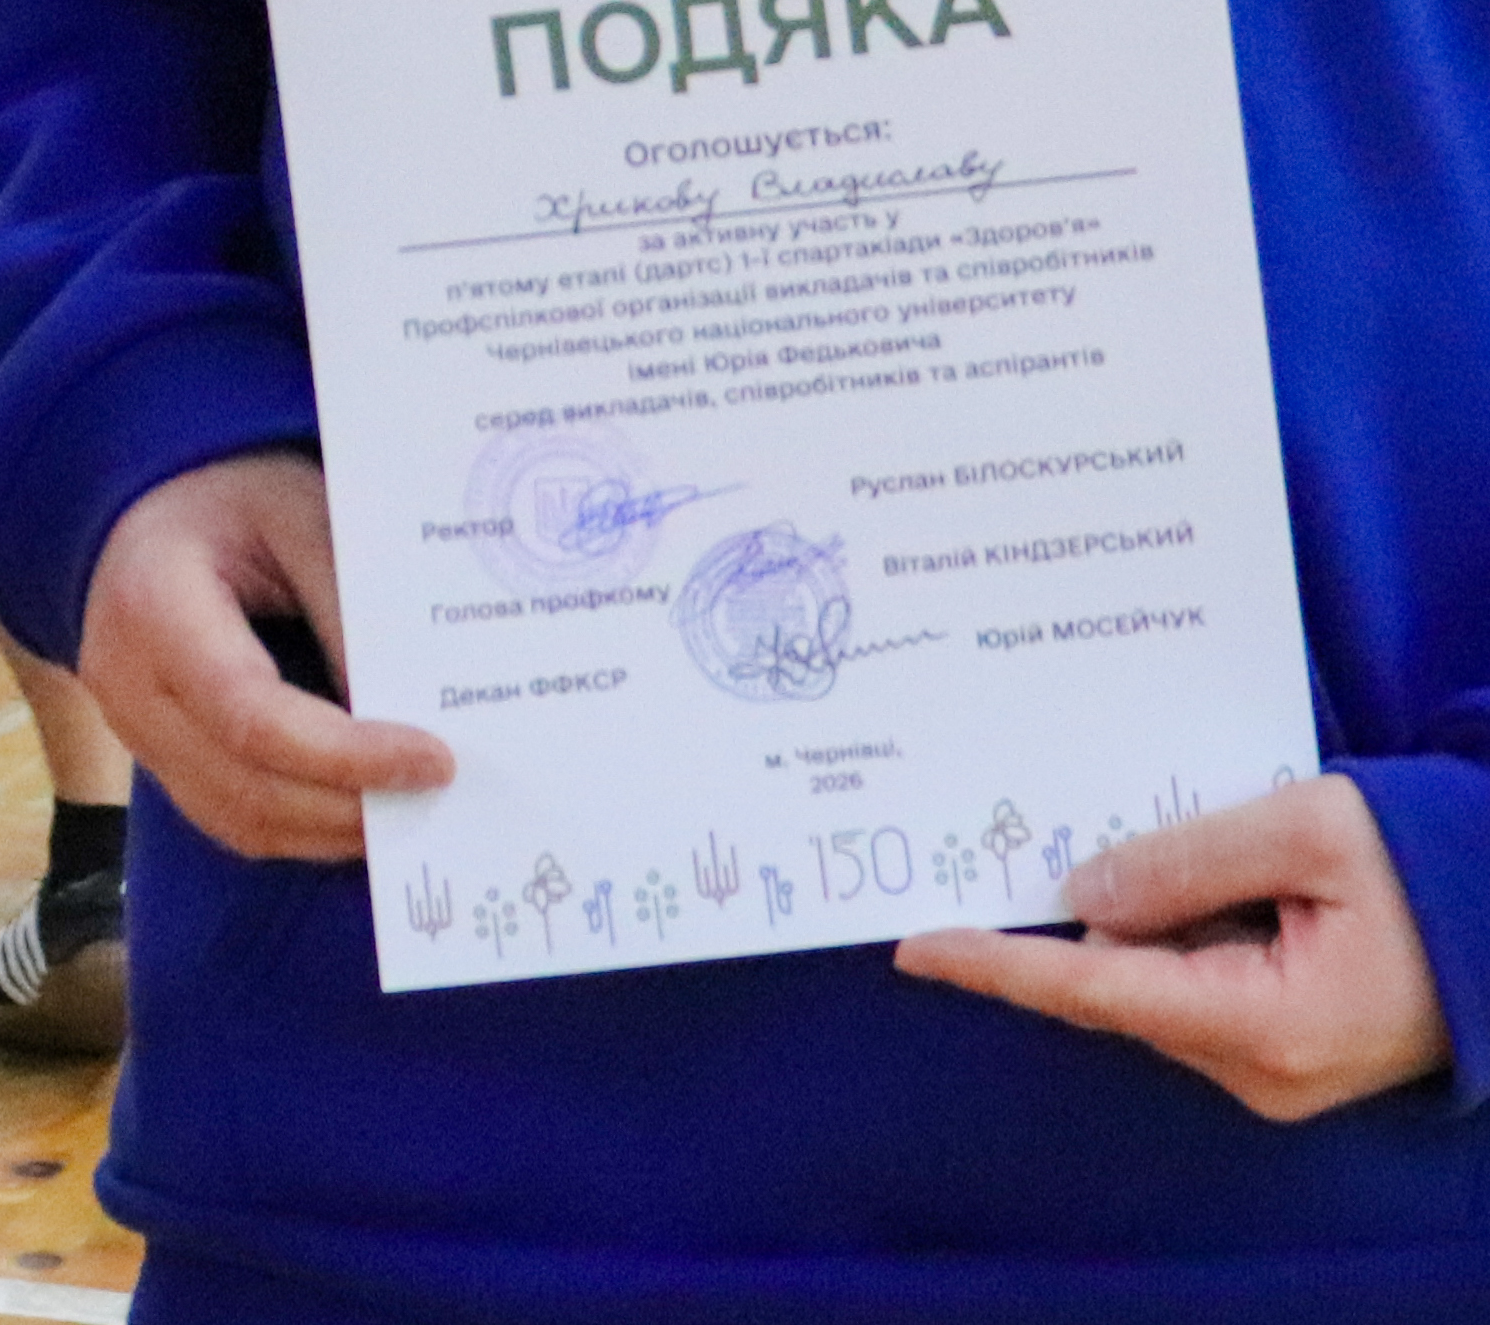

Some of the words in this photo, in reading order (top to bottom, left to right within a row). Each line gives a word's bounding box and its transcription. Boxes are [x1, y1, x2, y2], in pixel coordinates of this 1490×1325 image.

[623, 119, 891, 168] Оголошується:
[445, 276, 549, 300] п'ятому
[556, 263, 627, 290] етапі
[633, 252, 733, 284] (дартс)
[776, 234, 941, 266] спартакіади
[639, 234, 666, 252] за
[673, 222, 780, 249] активну
[788, 212, 878, 241] участь
[885, 211, 899, 228] у
[402, 296, 605, 340] Профспілкової
[611, 281, 757, 319] організації
[764, 269, 912, 301] викладачів
[921, 265, 949, 283] та
[956, 243, 1155, 280] співробітників
[485, 326, 685, 364] Чернівецького
[692, 304, 890, 341] національного
[896, 285, 1076, 324] університету
[474, 406, 557, 433] серед
[561, 389, 717, 424] викладачів,
[723, 366, 921, 405] співробітників
[928, 364, 958, 382] та
[964, 347, 1105, 379] аспірантів
[627, 357, 696, 381] імені
[703, 349, 770, 375] Юрія
[776, 332, 942, 365] Федьковича
[418, 510, 516, 546] Ректор
[849, 471, 946, 499] Руслан
[953, 437, 1185, 487] БІЛОСКУРСЬКИЙ
[430, 597, 524, 623] Голова
[529, 583, 670, 615] профкому
[882, 546, 977, 577] Віталій
[983, 519, 1194, 565] КІНДЗЕРСЬКИЙ
[439, 683, 522, 710] Декан
[528, 667, 628, 697] ФФКСР
[975, 623, 1044, 651] Юрій
[1051, 606, 1205, 641] МОСЕЙЧУК
[810, 770, 864, 794] 2026
[806, 821, 917, 906] 150
